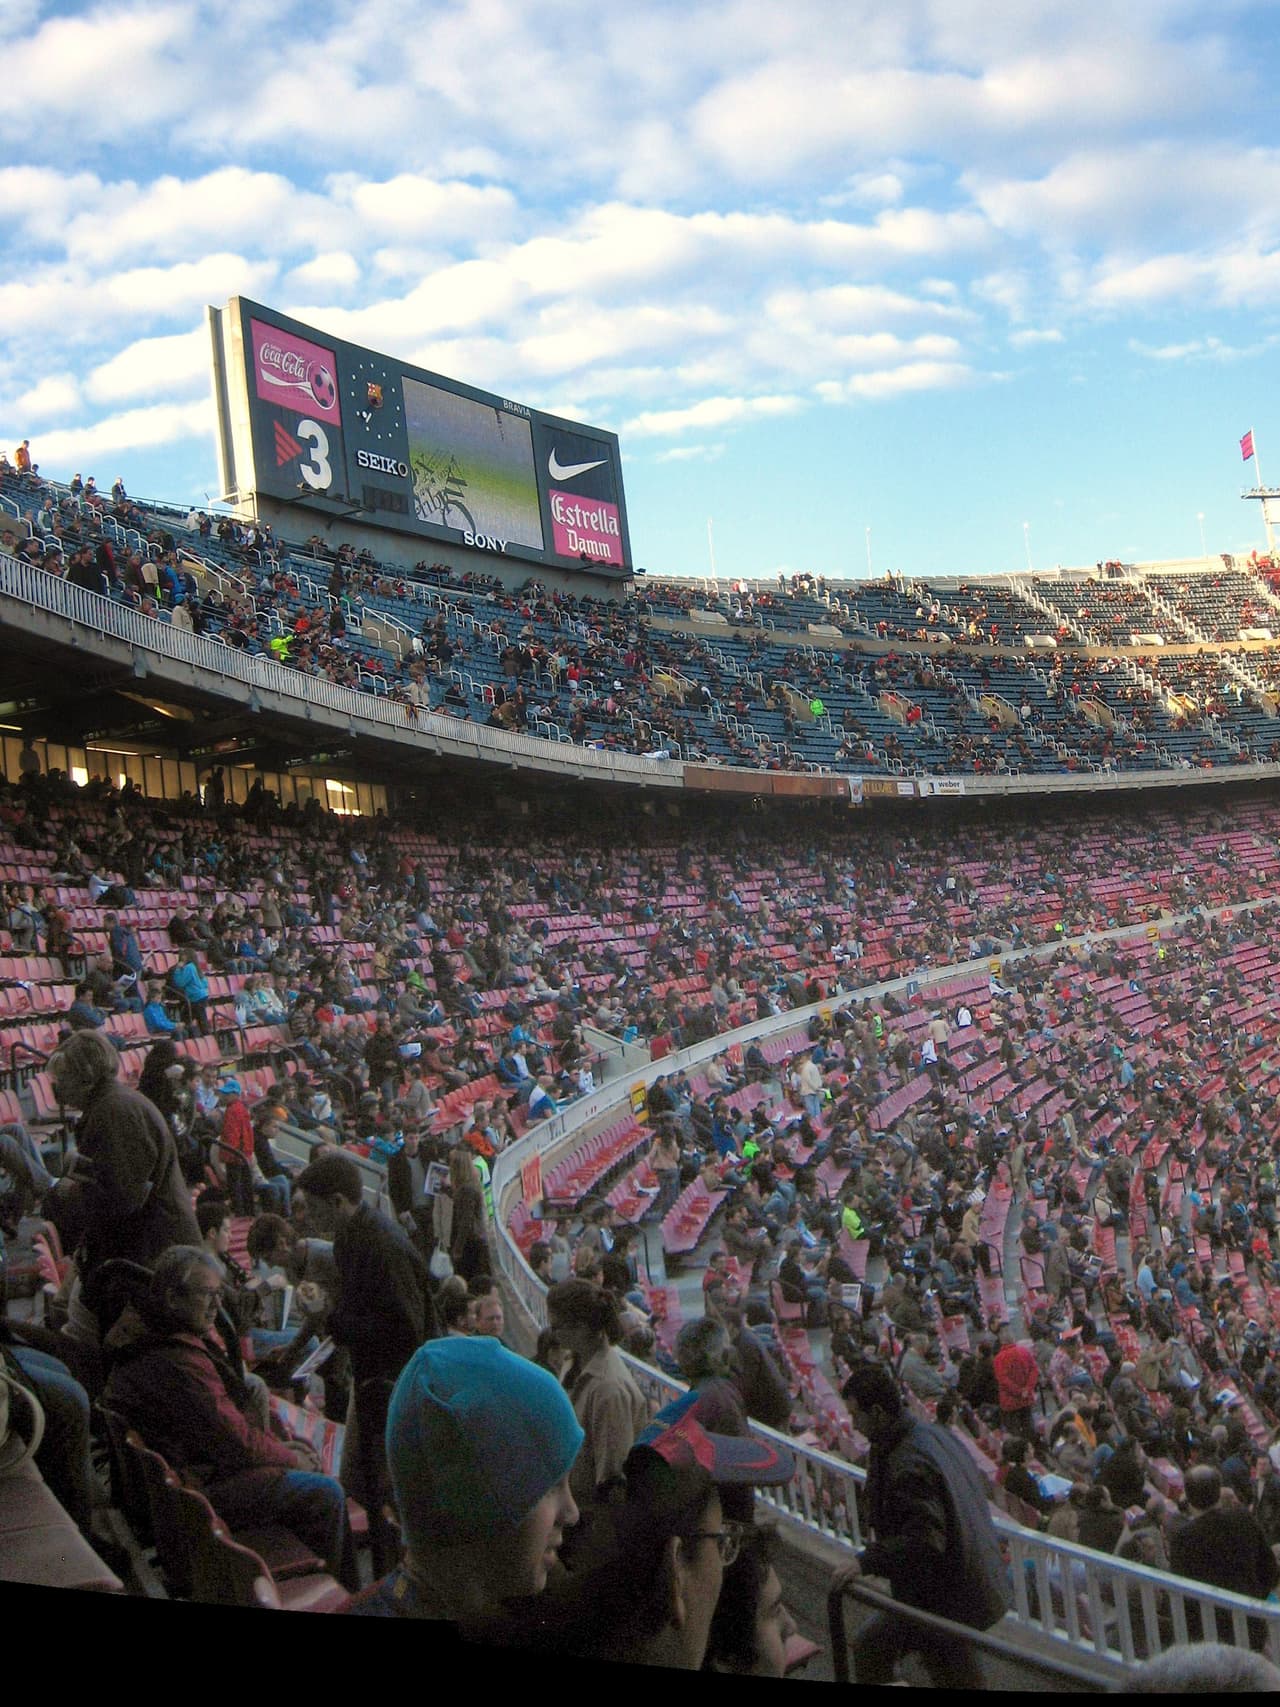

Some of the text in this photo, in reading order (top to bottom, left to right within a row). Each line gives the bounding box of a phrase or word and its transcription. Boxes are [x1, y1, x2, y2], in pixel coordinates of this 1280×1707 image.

[260, 342, 306, 379] Coca-Cola
[502, 399, 532, 418] BRAVIA
[297, 419, 332, 489] 3
[357, 450, 408, 478] SEIKO
[551, 494, 620, 536] Estrella
[463, 530, 509, 554] SONY
[567, 528, 612, 558] Damm
[938, 780, 960, 788] weber
